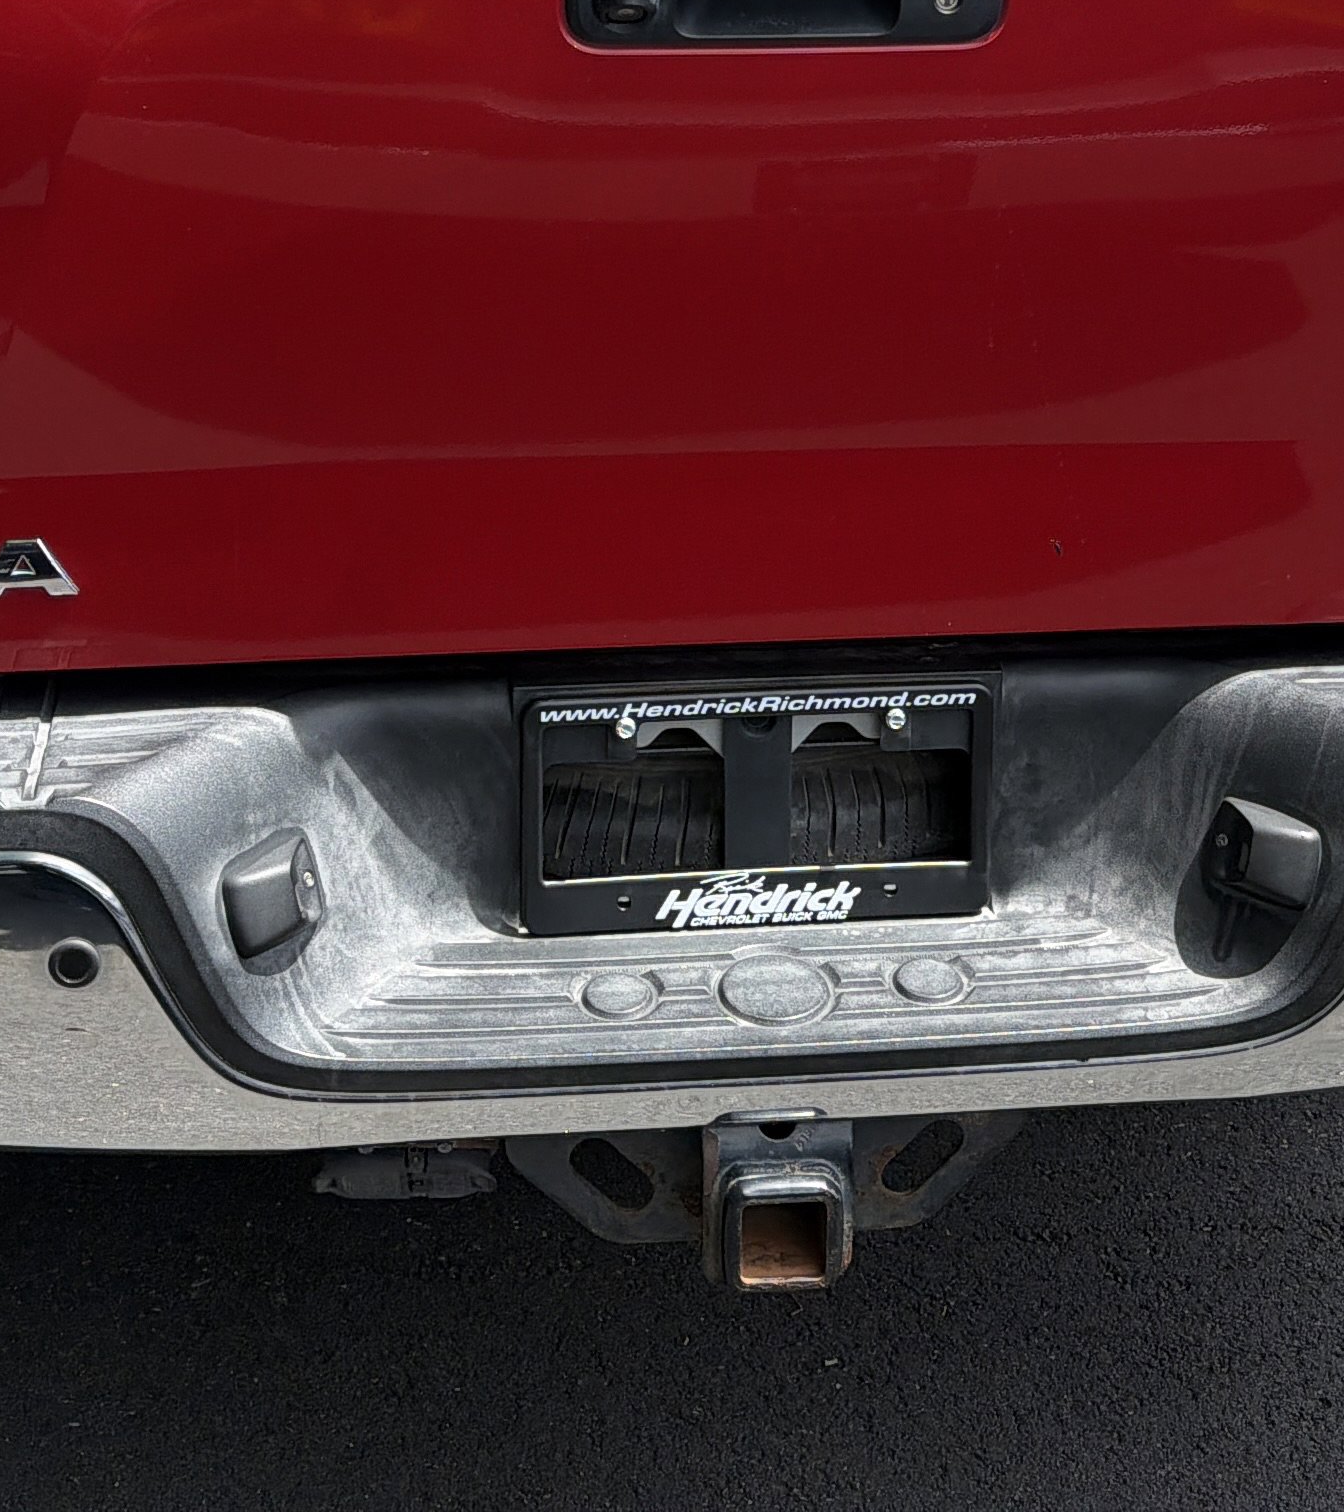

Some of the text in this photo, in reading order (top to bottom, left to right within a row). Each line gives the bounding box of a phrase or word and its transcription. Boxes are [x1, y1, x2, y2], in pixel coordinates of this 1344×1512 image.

[540, 691, 977, 723] www.HendrickRichmond.com
[655, 880, 862, 929] Hendrick
[689, 909, 849, 927] CHEVROLET BUICK GMC
